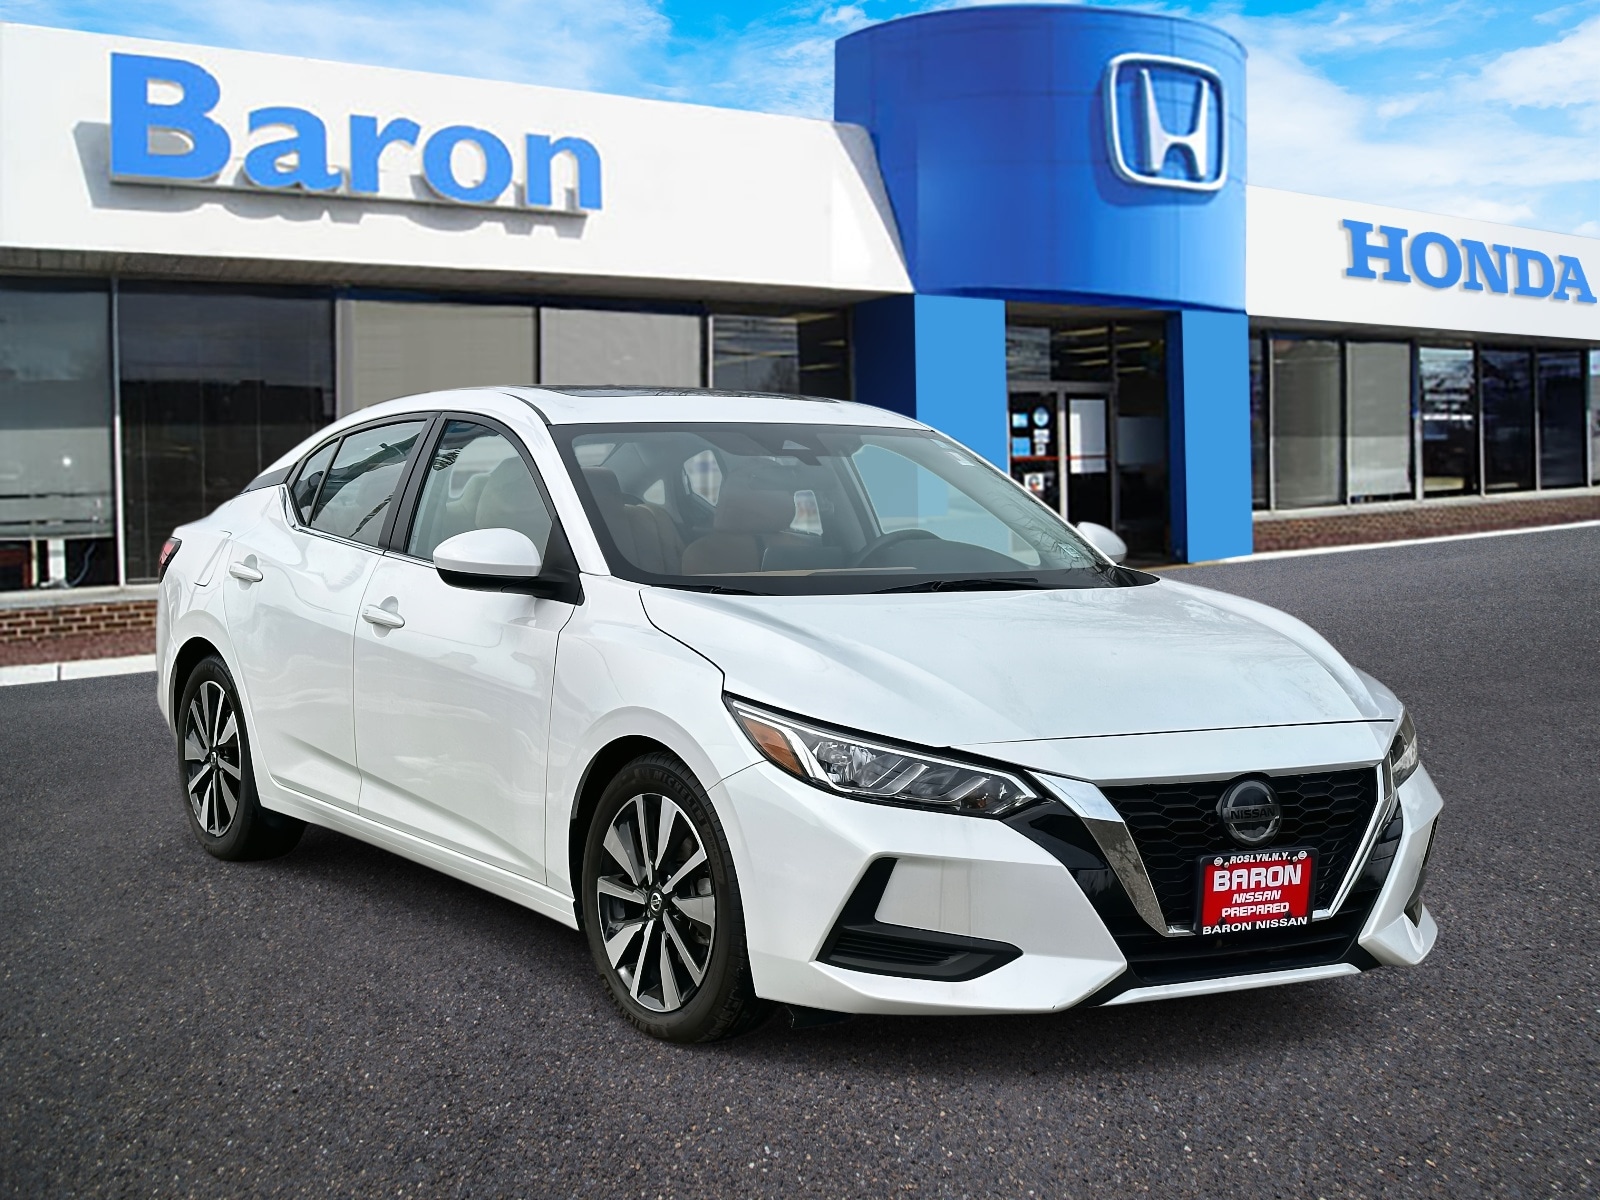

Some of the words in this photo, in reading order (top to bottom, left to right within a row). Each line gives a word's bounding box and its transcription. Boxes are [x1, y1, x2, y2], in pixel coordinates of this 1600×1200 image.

[110, 52, 602, 210] Baron
[1342, 218, 1598, 304] HONDA
[653, 770, 706, 822] MICHELIN
[1230, 807, 1275, 820] NISSAN
[1213, 864, 1302, 892] BARON
[1231, 890, 1282, 904] NISSAN
[1221, 902, 1290, 918] PREPARED
[1202, 921, 1252, 935] BARON
[1255, 916, 1308, 930] NISSAN
